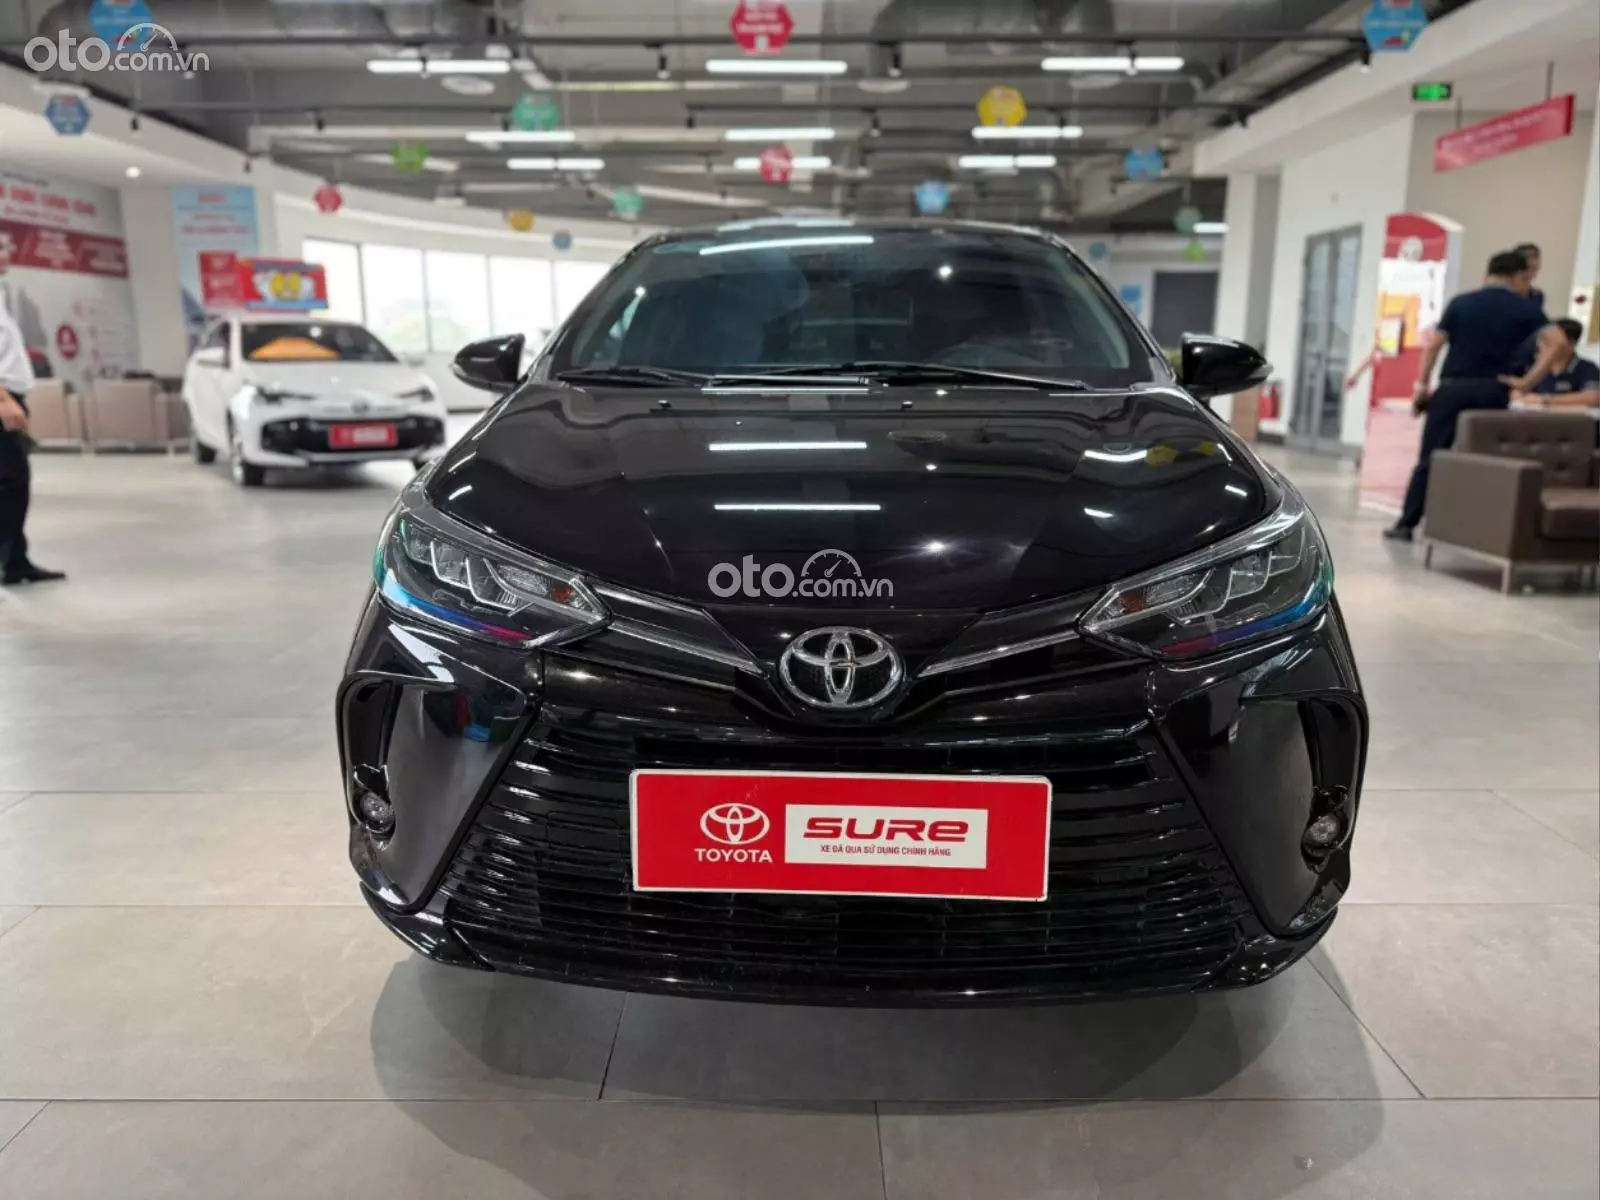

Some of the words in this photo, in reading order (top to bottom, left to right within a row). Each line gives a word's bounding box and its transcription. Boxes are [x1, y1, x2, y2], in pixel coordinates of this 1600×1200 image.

[820, 844, 830, 853] XE
[845, 845, 862, 854] QUA
[694, 848, 773, 864] TOYOTA
